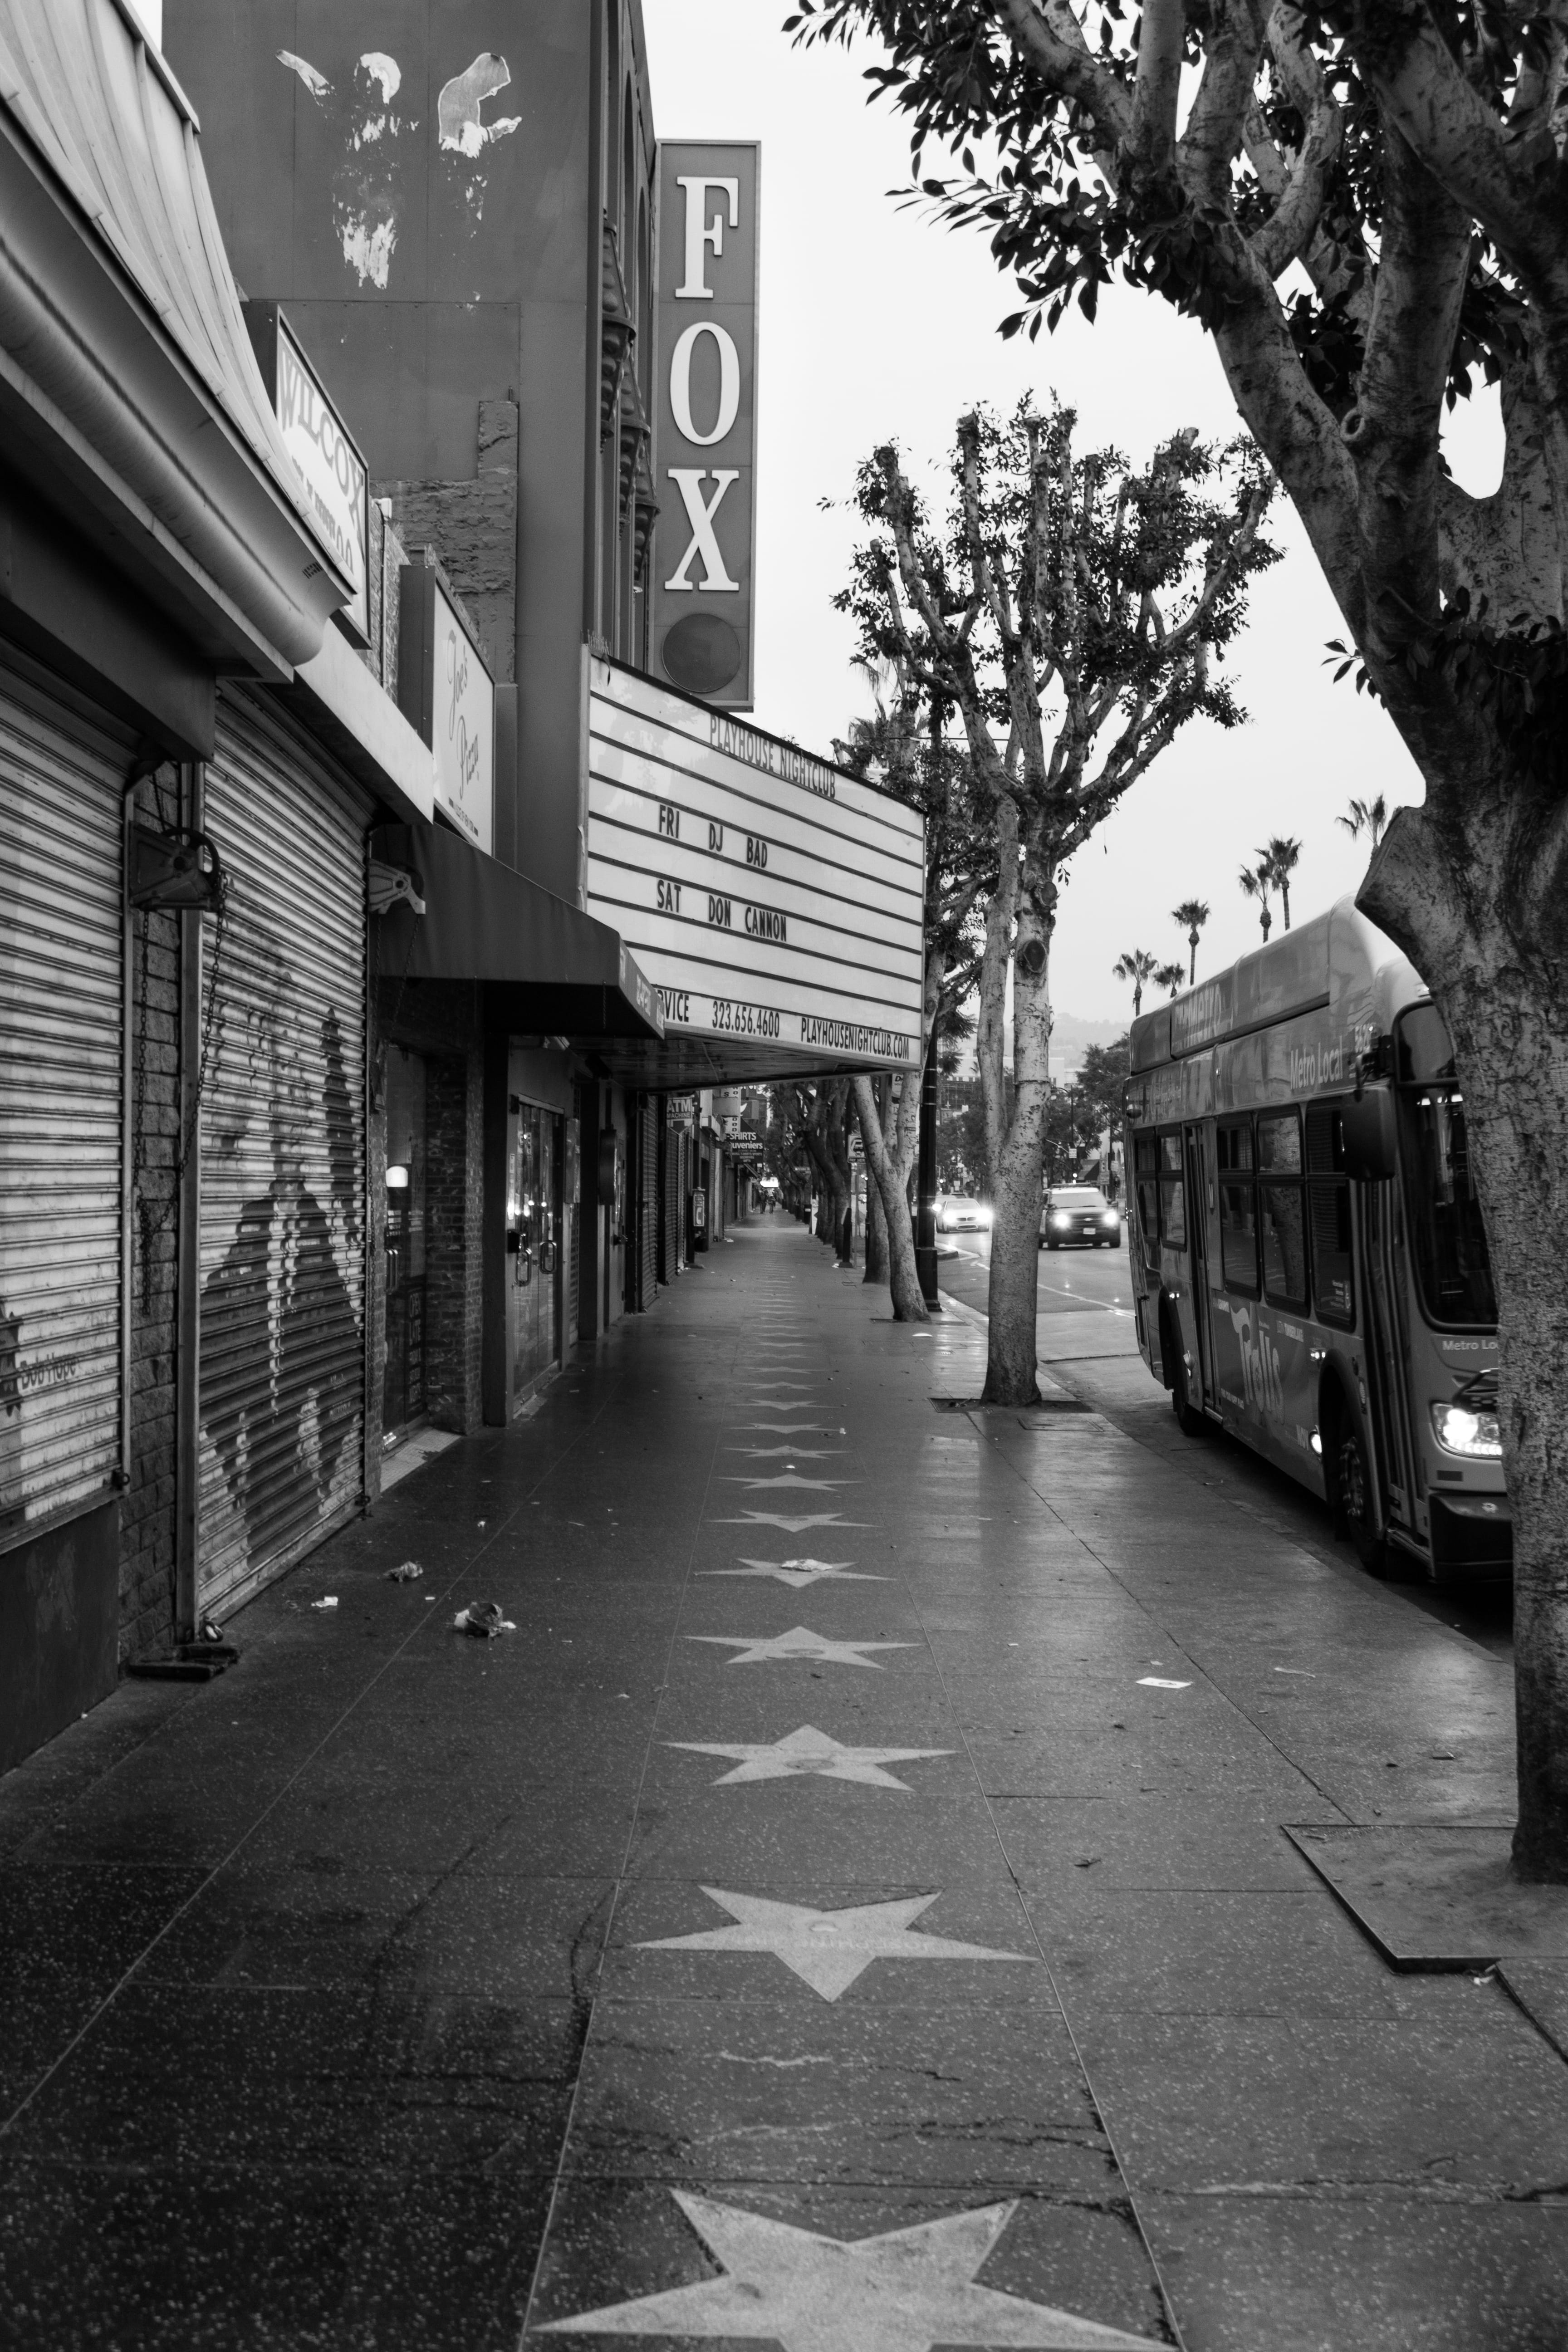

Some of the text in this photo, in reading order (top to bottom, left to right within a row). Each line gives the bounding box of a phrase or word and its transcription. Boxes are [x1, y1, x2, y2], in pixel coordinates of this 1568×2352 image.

[664, 176, 740, 591] FOX
[278, 348, 365, 566] WILCOX
[447, 629, 468, 741] Joe's
[710, 714, 836, 799] PLAYHOUSE NIGHTCLUB
[658, 804, 768, 868] FRI DJ BAD
[657, 880, 787, 942] SAT DON CANNON
[712, 1000, 780, 1039] 323.656.4600
[801, 1017, 909, 1060] PLAYHOUSENIGHTCLUB.COM
[1290, 1045, 1315, 1090] Metro
[1318, 1036, 1343, 1084] Local
[666, 1099, 691, 1113] ATM
[727, 1132, 757, 1140] -SHIRTS
[732, 1141, 763, 1149] uveniers
[1442, 1339, 1498, 1351] Metro Lo
